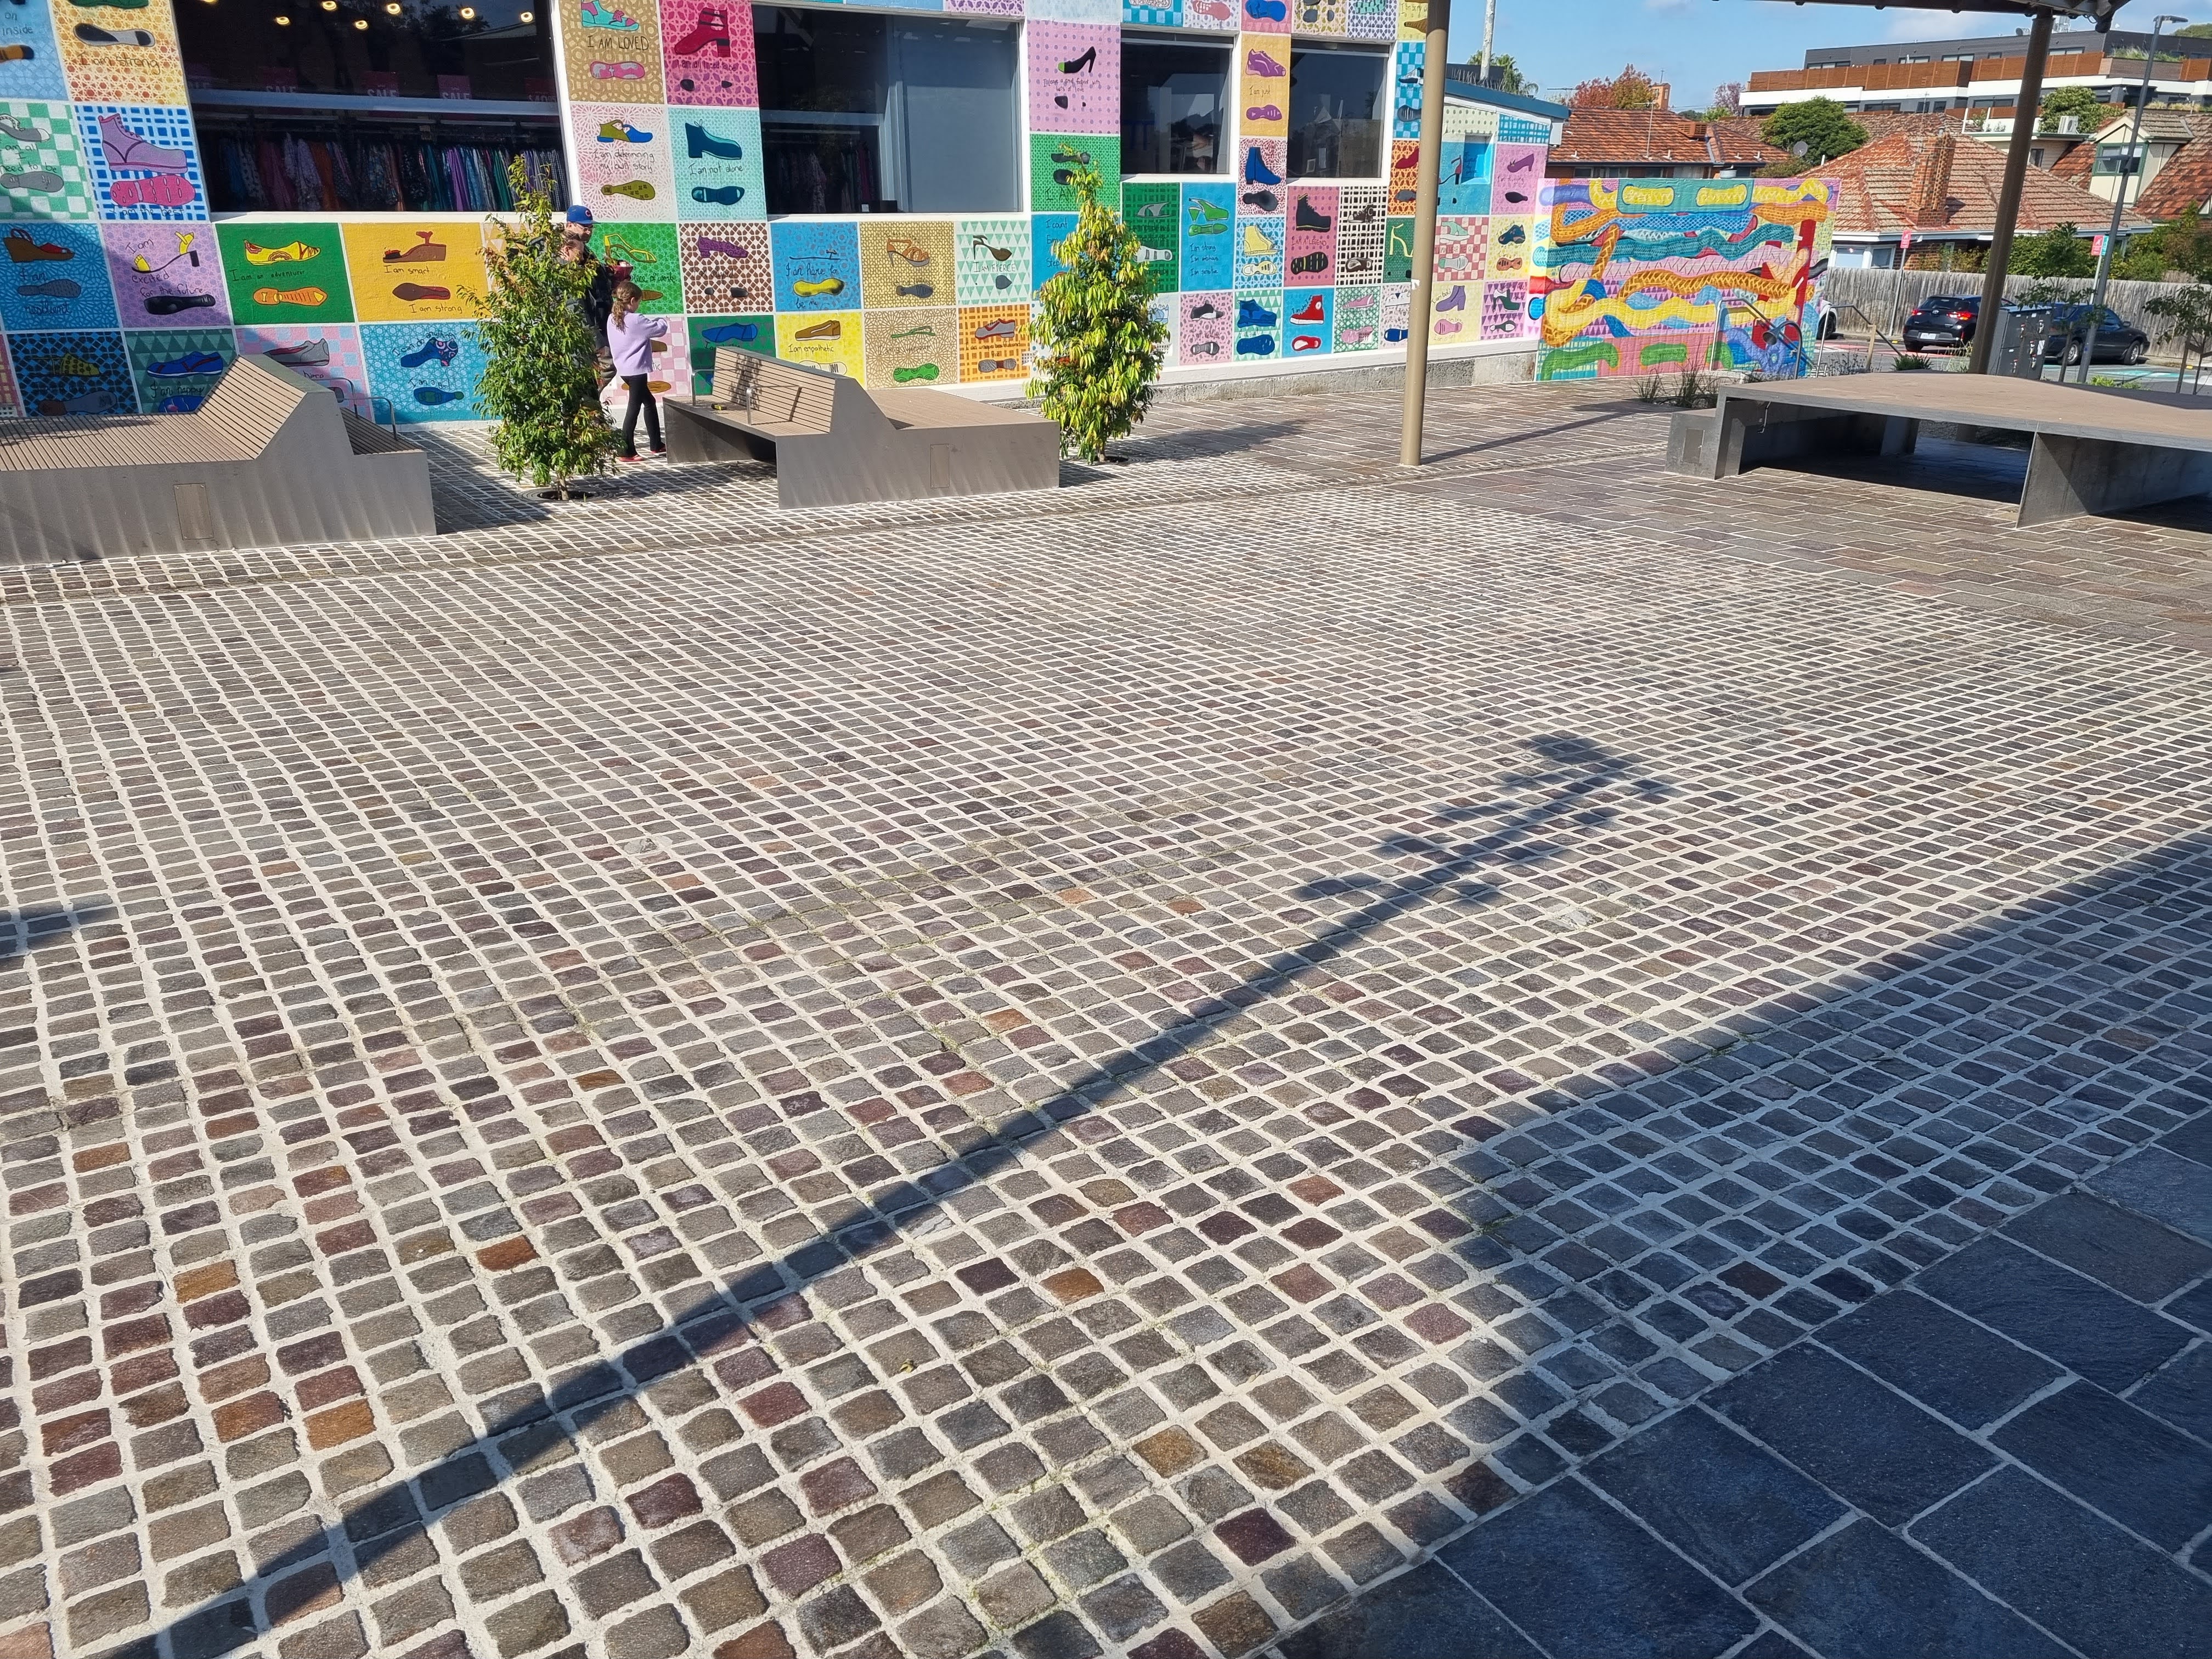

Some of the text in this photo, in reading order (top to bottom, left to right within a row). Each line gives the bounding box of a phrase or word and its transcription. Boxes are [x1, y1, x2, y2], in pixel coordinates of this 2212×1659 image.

[5, 12, 17, 21] on
[588, 35, 649, 50] I AM LOVED
[78, 52, 161, 75] I am strong
[25, 143, 37, 151] all
[45, 162, 58, 173] be
[599, 163, 612, 175] my
[633, 160, 653, 174] story
[688, 162, 697, 176] I
[709, 161, 722, 173] not
[726, 162, 743, 173] alone
[1045, 187, 1054, 201] I
[139, 207, 154, 216] the
[160, 208, 185, 217] best
[125, 239, 154, 254] I am
[383, 264, 392, 274] I
[408, 266, 430, 274] smart
[806, 263, 825, 277] here
[830, 264, 838, 274] to
[973, 261, 981, 273] I
[991, 263, 1016, 273] FIERCE
[132, 270, 170, 284] excited
[230, 268, 240, 282] I
[139, 284, 204, 298] for the future
[409, 303, 417, 313] I
[436, 303, 462, 314] strong
[795, 297, 806, 308] be
[392, 347, 401, 356] I
[400, 343, 415, 353] can
[416, 338, 425, 347] do
[788, 343, 793, 353] I
[176, 382, 205, 396] happy
[408, 377, 416, 389] I
